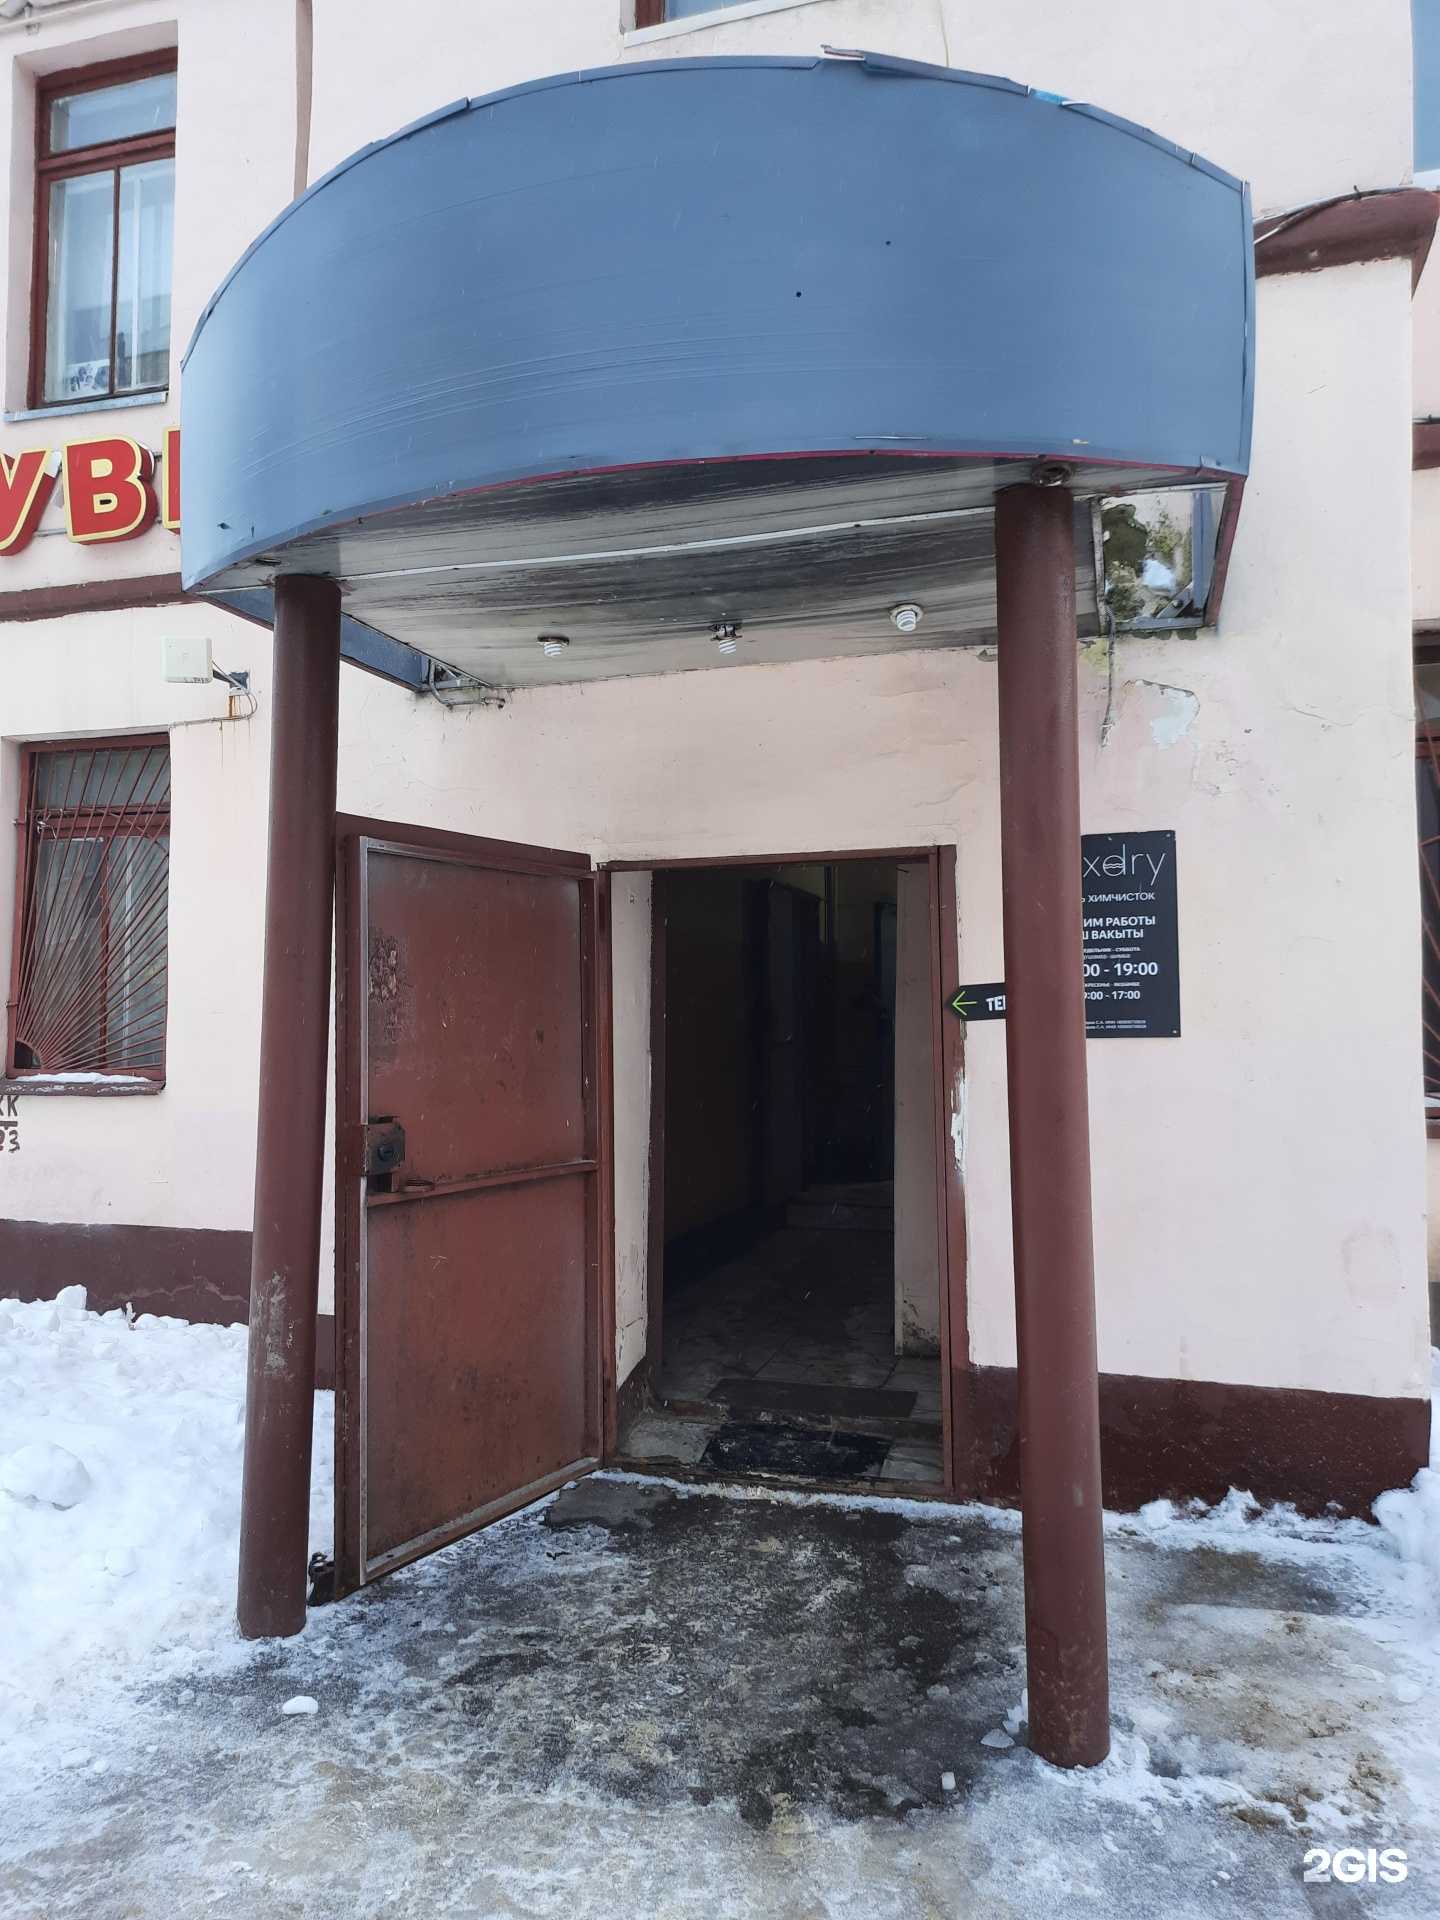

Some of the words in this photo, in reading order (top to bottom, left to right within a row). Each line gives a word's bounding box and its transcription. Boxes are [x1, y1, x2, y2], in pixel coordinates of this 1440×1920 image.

[1087, 892, 1155, 903] ХИМЧИСТОК
[1106, 915, 1156, 927] РАБОТЫ
[1091, 928, 1144, 940] ВАКЫТЫ
[1114, 962, 1159, 976] 19:00
[1111, 990, 1141, 1000] 17:00
